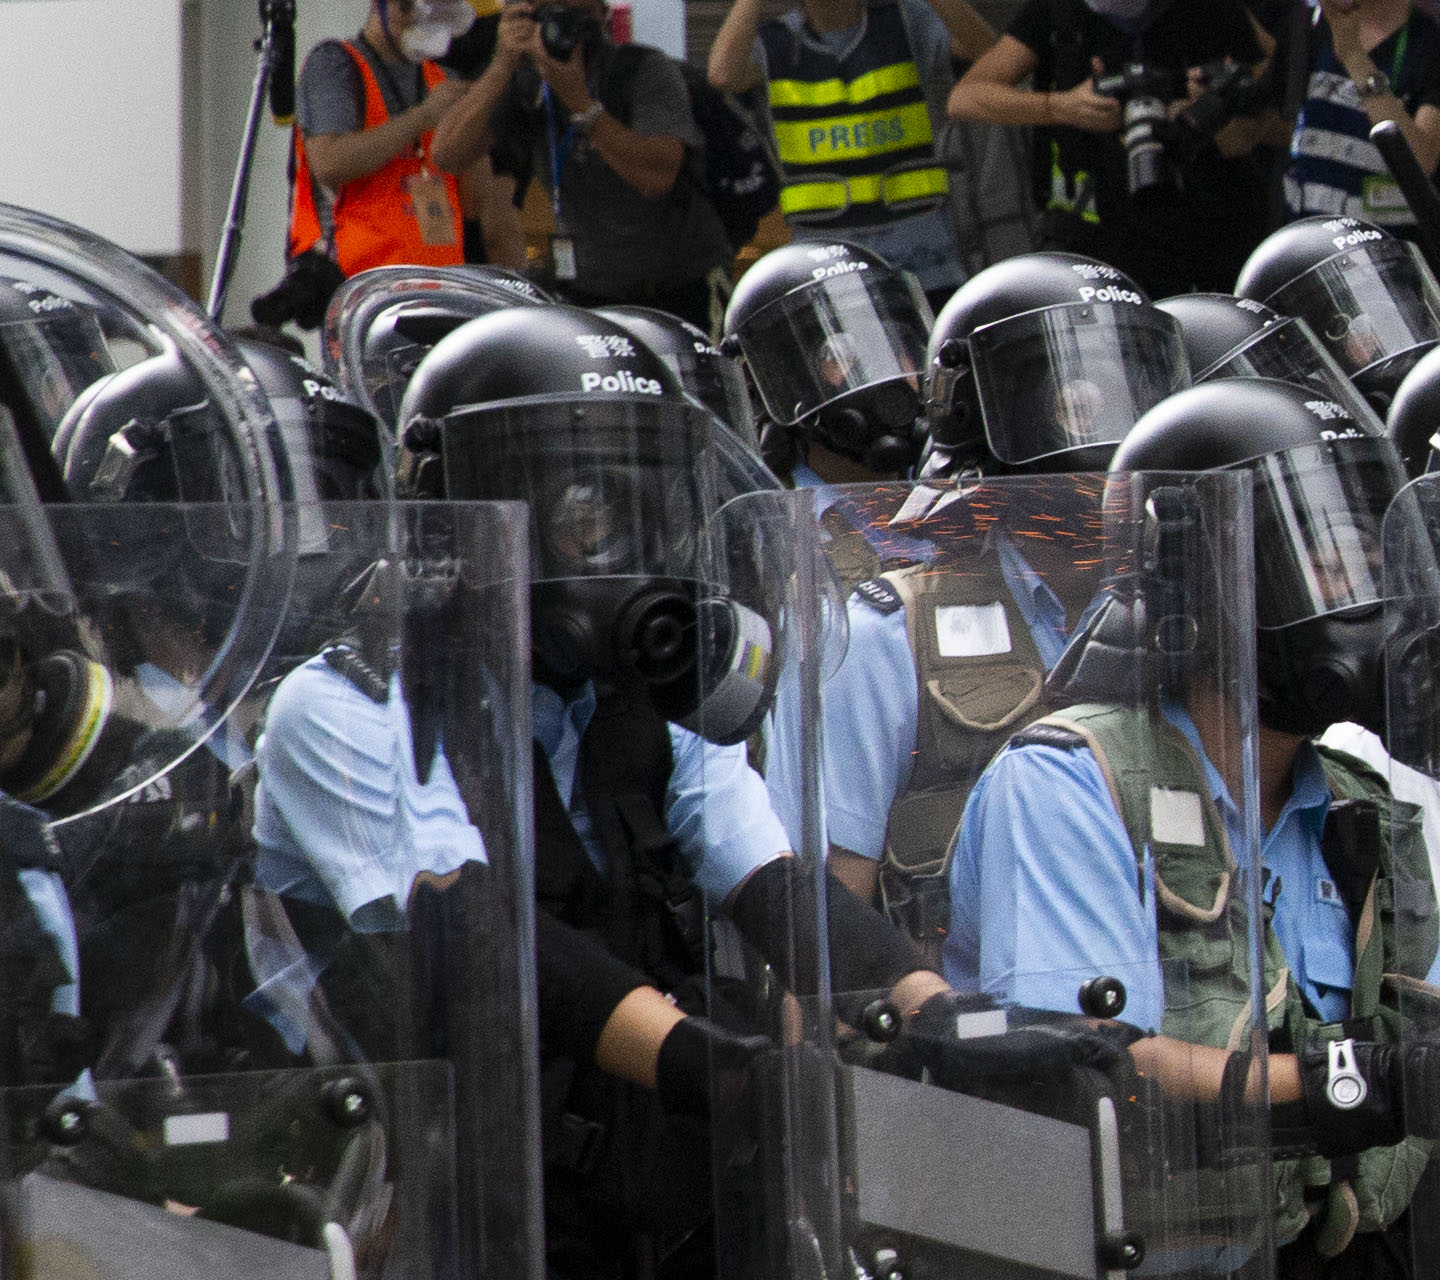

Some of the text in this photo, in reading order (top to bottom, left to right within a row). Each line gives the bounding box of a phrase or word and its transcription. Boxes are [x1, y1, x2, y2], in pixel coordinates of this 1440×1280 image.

[808, 117, 905, 154] PRESS
[1333, 230, 1383, 250] Police
[1079, 286, 1142, 305] Police
[580, 371, 663, 395] Police
